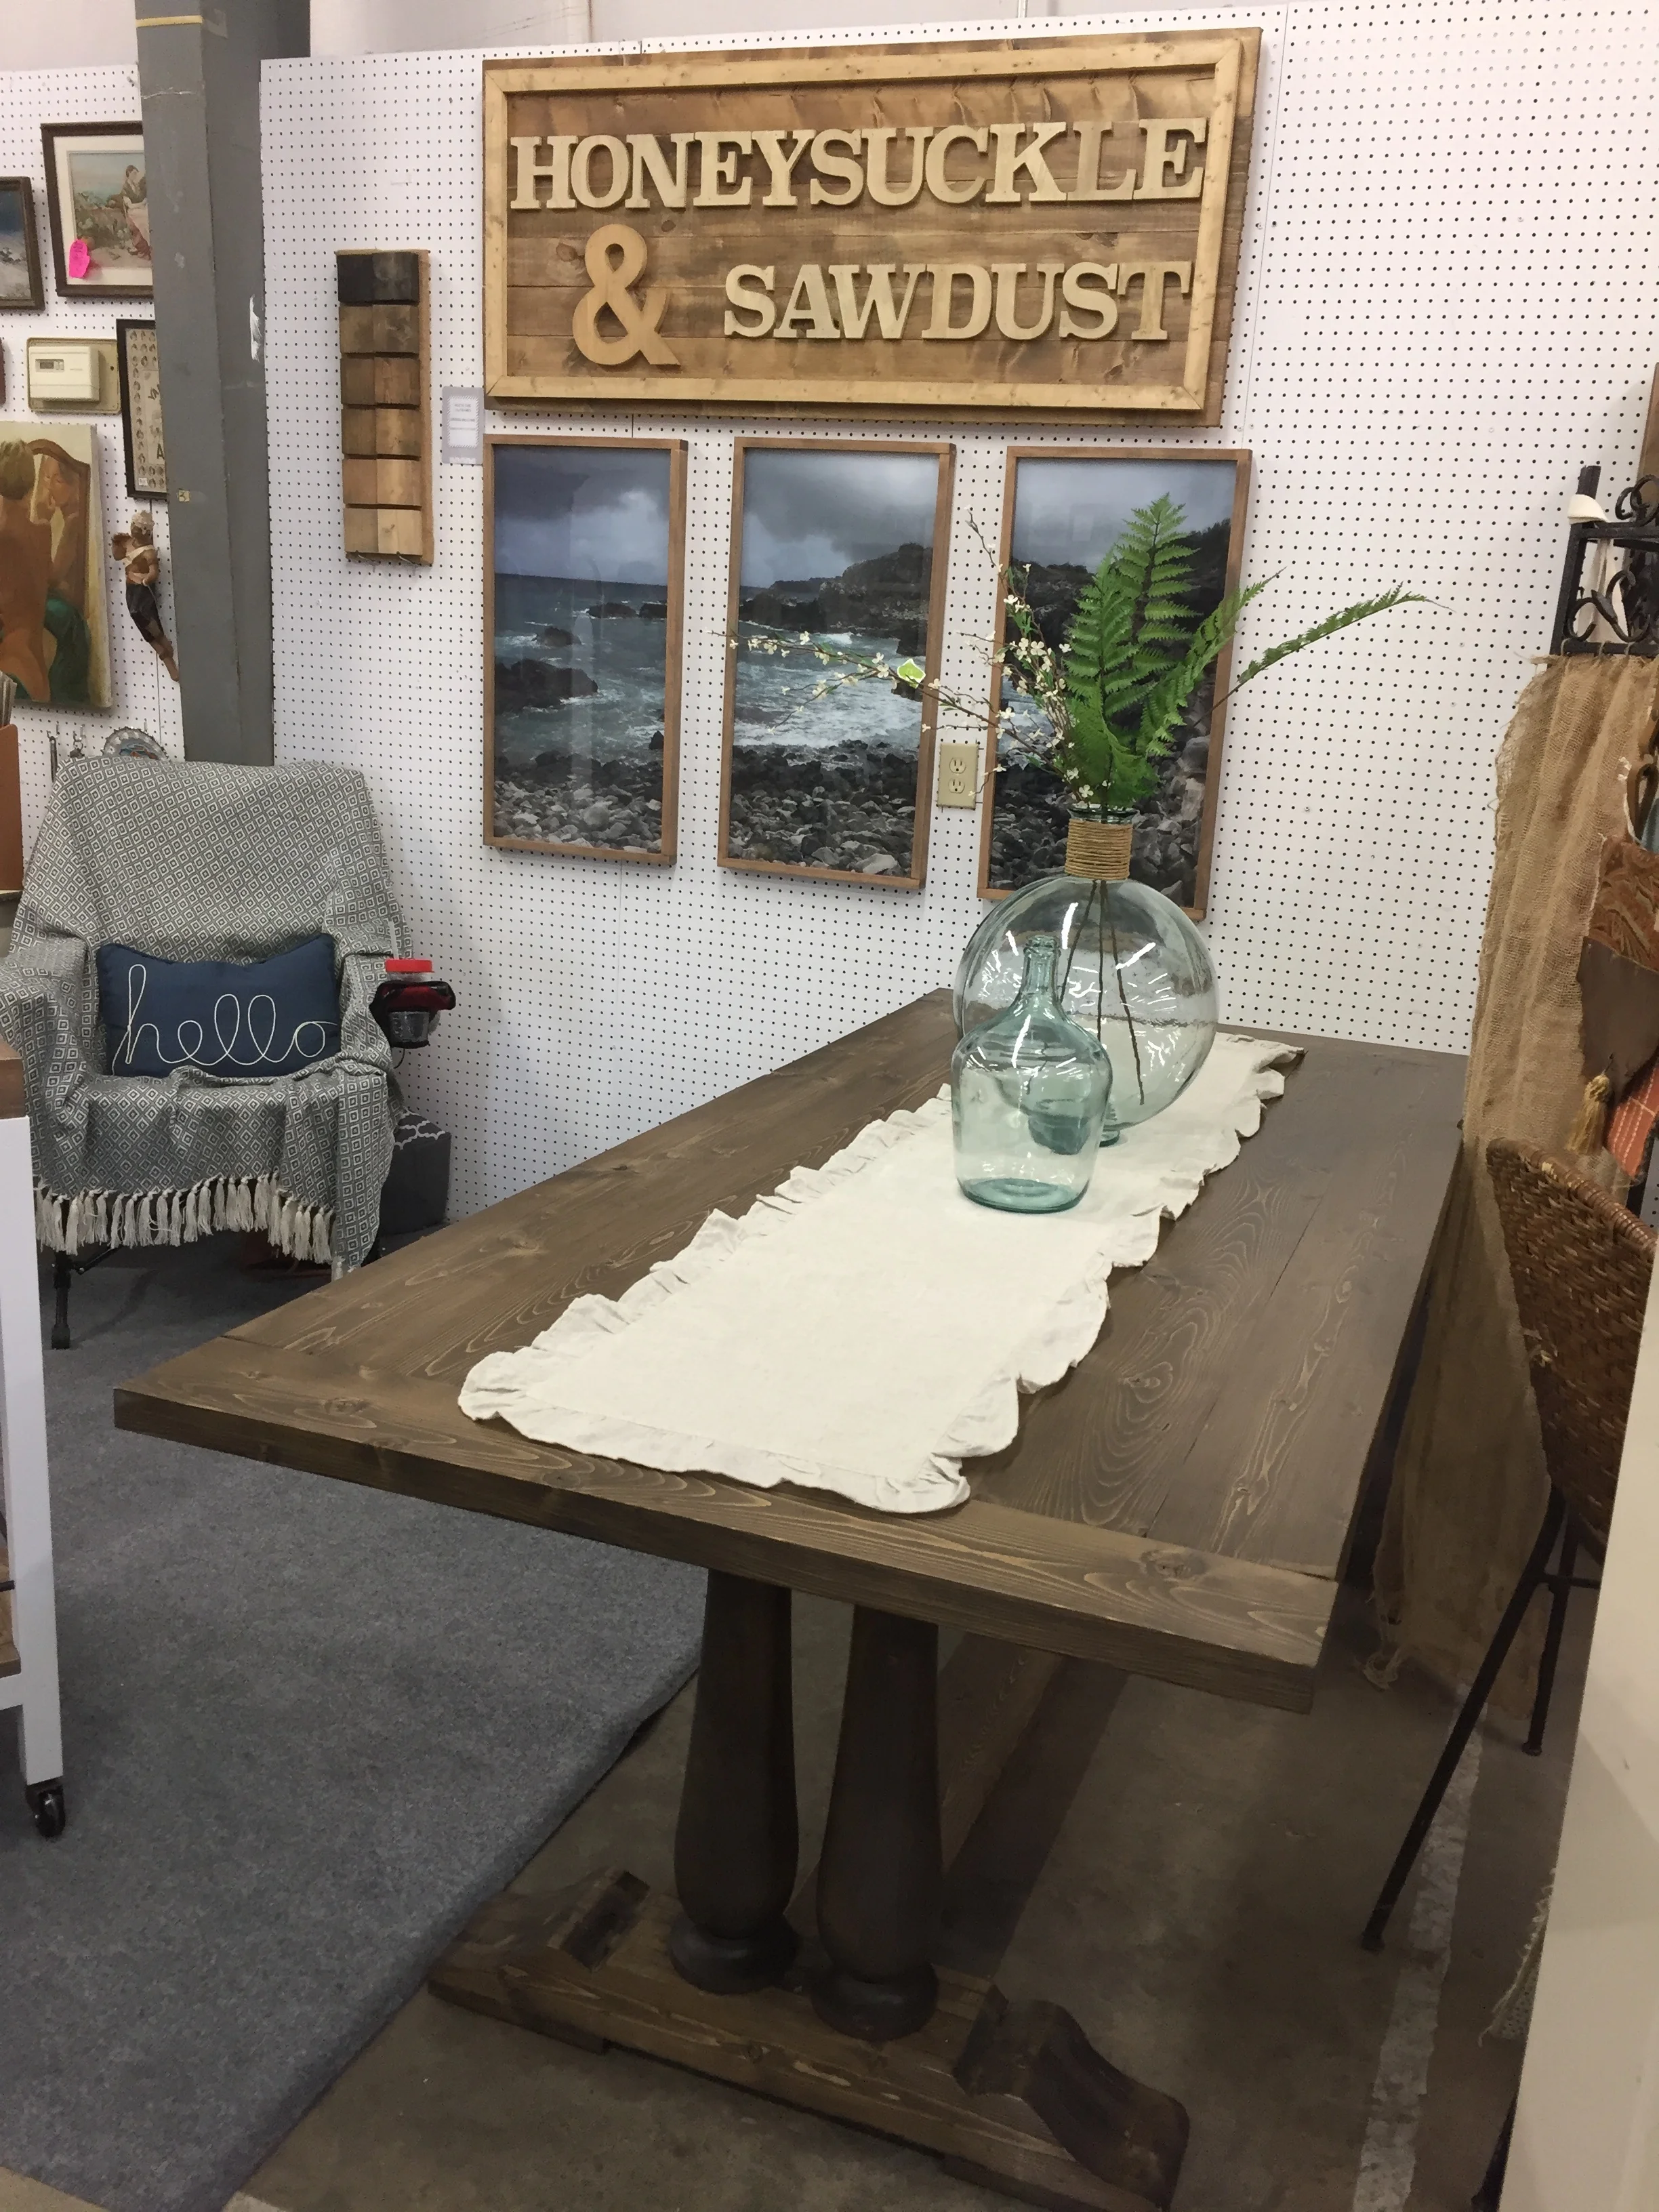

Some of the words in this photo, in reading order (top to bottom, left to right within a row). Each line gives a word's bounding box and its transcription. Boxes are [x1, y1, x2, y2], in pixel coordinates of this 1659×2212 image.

[510, 118, 1205, 209] HONEYSUCKLE
[571, 224, 680, 367] &
[723, 260, 1191, 341] SAWDUST
[111, 964, 337, 1075] hello
